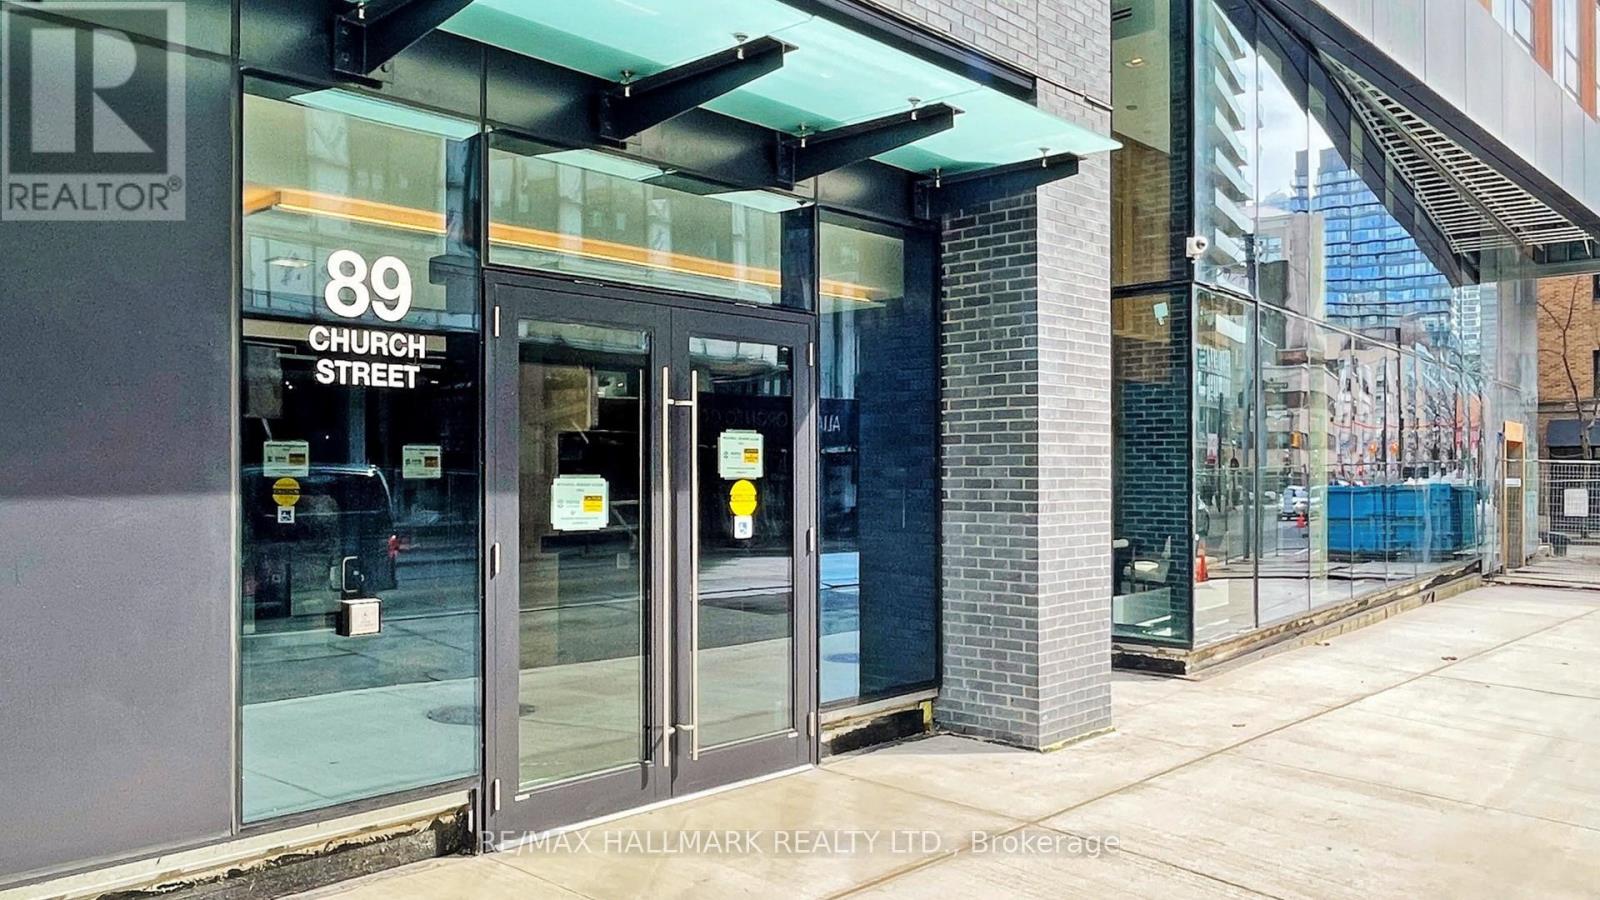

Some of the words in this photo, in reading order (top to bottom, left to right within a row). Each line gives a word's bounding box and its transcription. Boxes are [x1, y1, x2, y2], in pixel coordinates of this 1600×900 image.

[324, 249, 412, 322] 89
[308, 325, 426, 359] CHURCH
[315, 358, 420, 389] STREET
